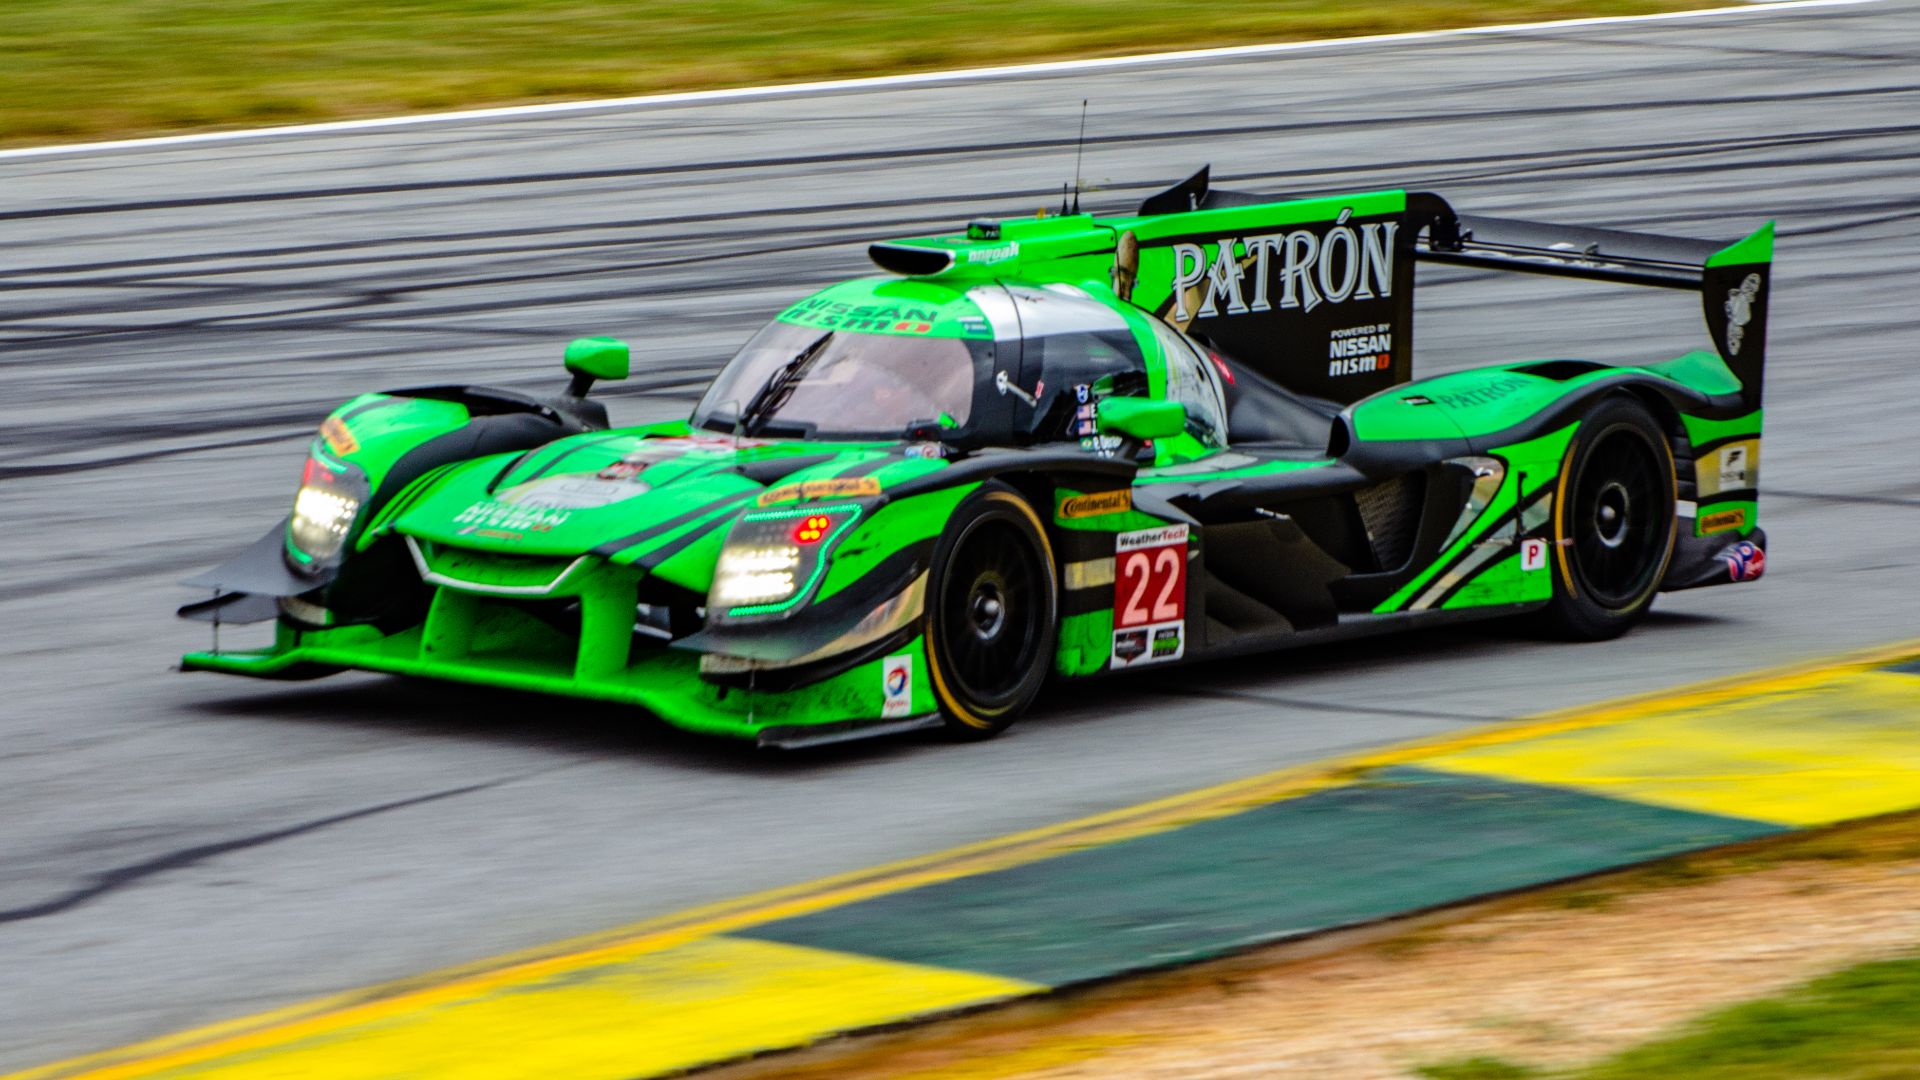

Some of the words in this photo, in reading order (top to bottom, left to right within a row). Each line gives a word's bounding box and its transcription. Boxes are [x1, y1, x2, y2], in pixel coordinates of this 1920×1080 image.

[1171, 208, 1399, 322] PATRÓN
[803, 298, 938, 323] NISSAN
[1330, 324, 1376, 339] POWERED
[1377, 322, 1391, 333] BY
[1329, 333, 1391, 359] NISSAN
[1329, 353, 1390, 377] nismo
[1063, 493, 1121, 518] Continental
[1120, 528, 1187, 547] WeatherTech
[1528, 544, 1539, 566] P
[1121, 547, 1181, 626] 22
